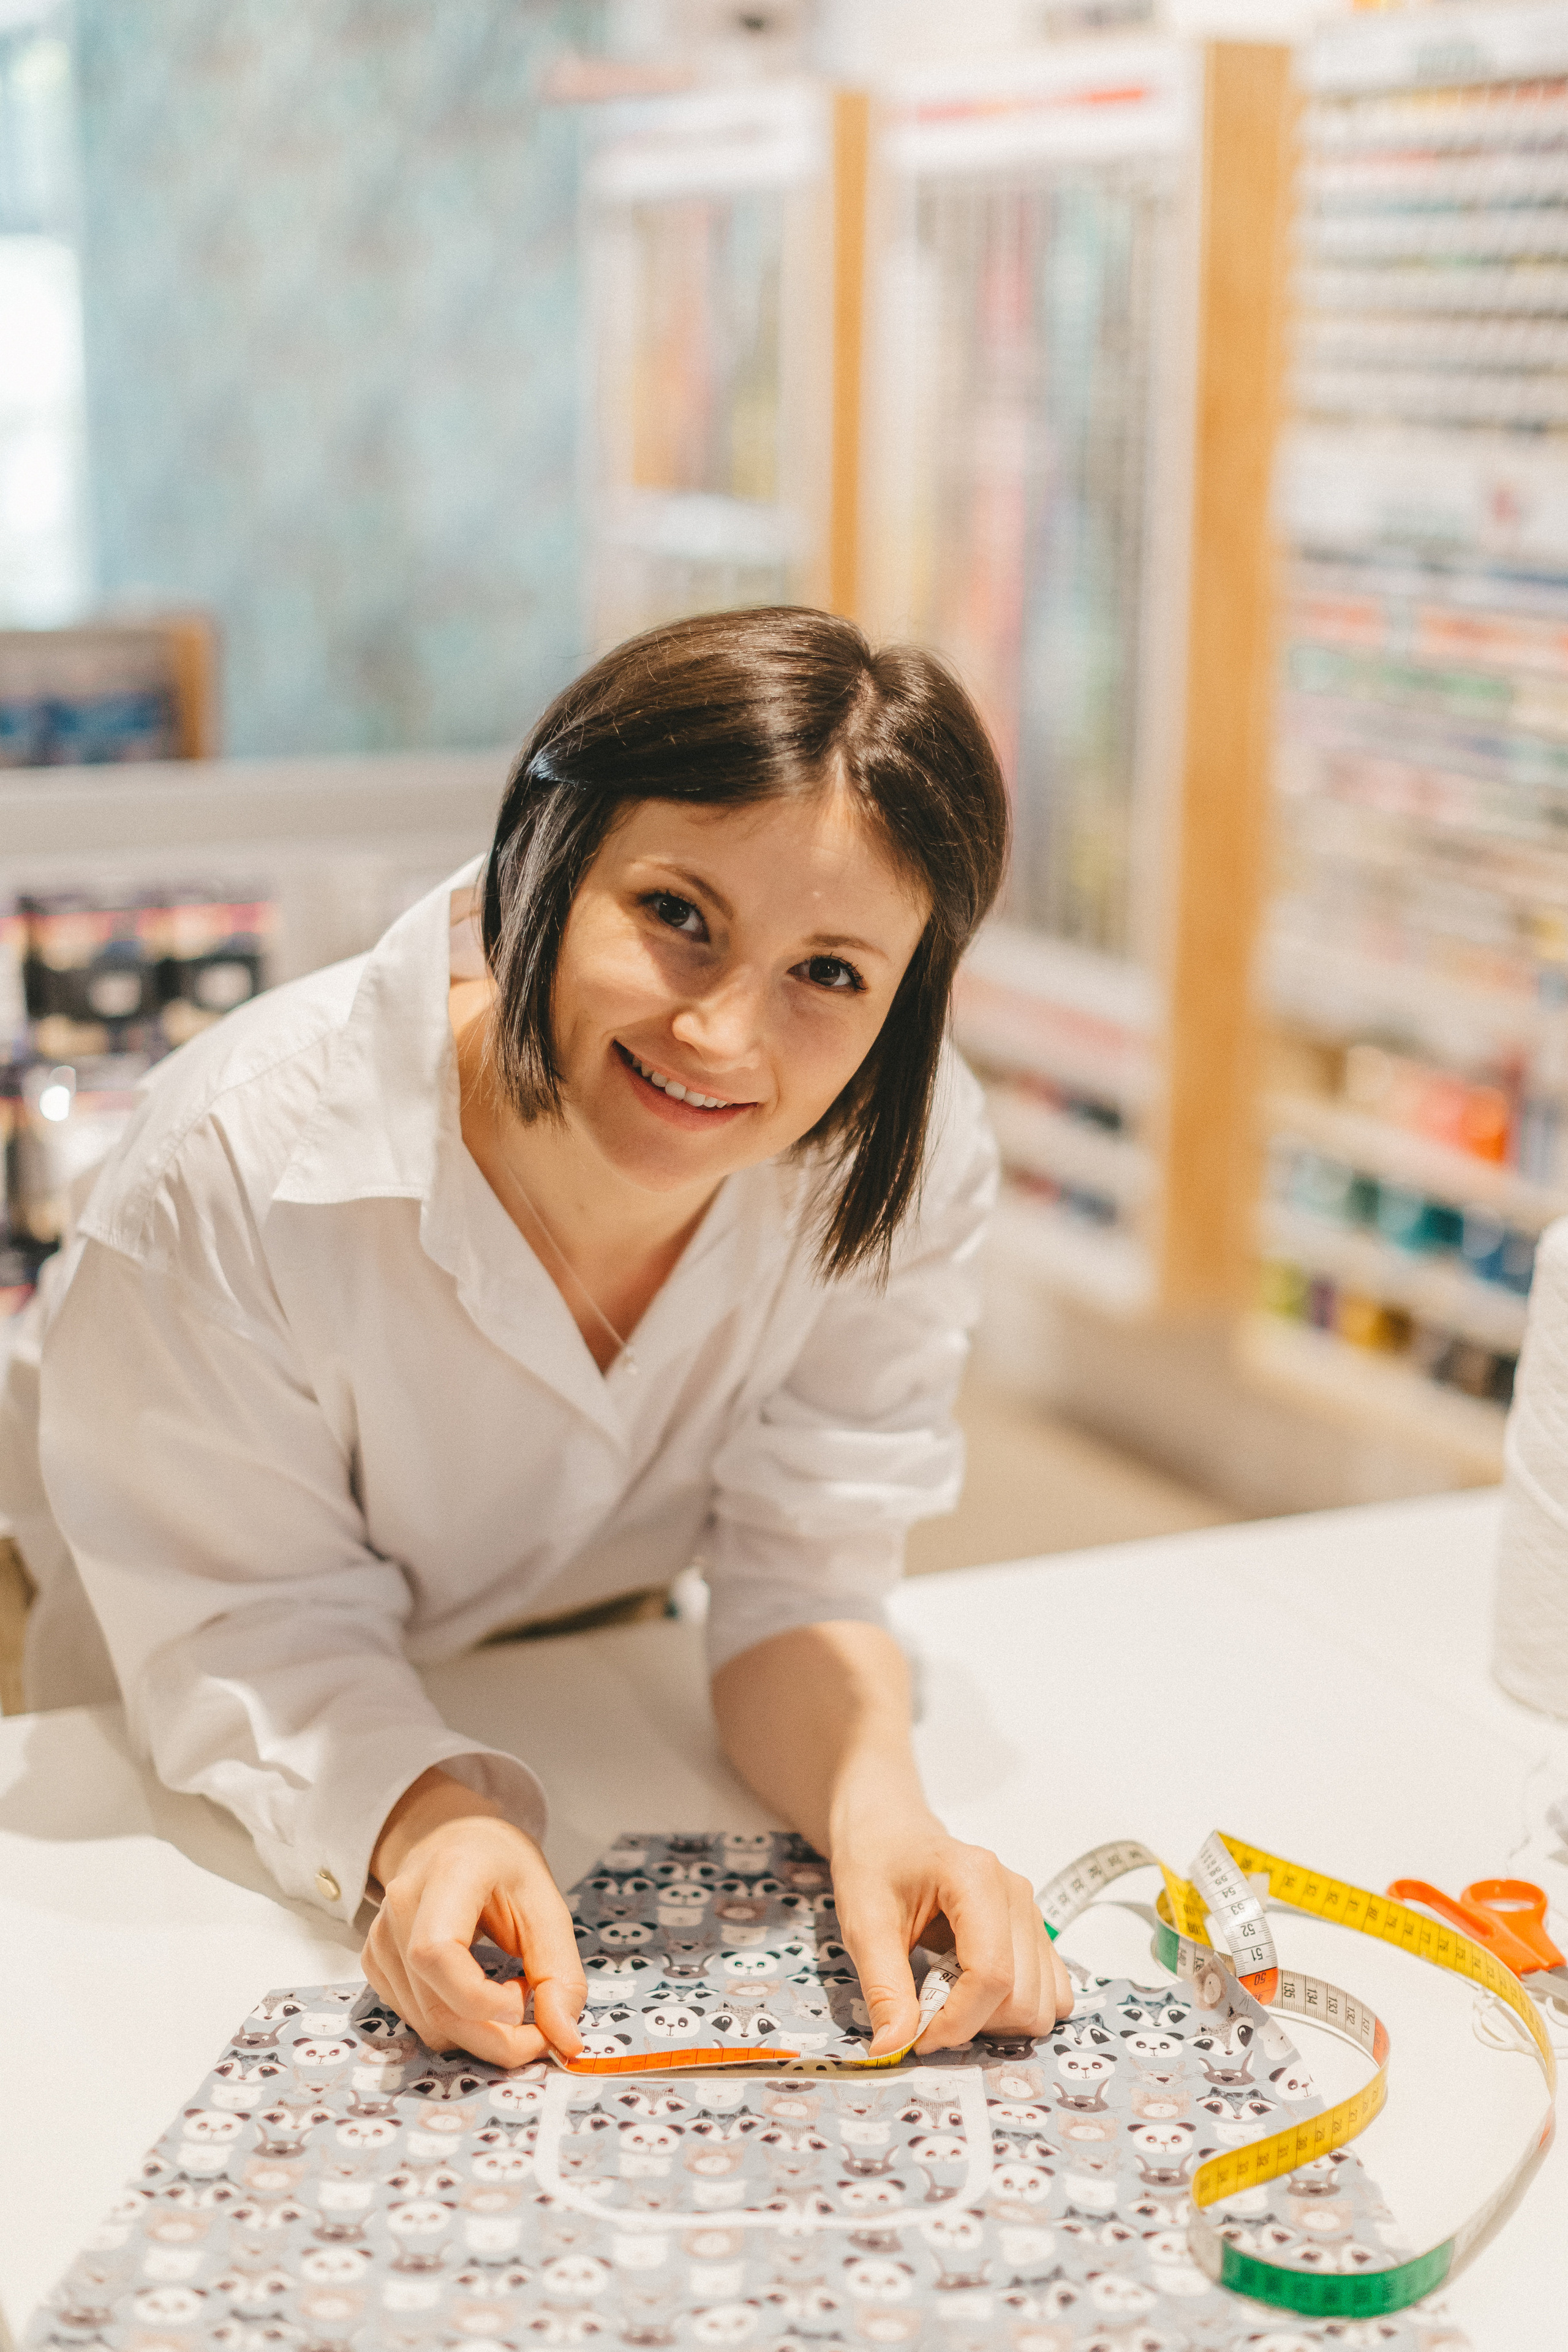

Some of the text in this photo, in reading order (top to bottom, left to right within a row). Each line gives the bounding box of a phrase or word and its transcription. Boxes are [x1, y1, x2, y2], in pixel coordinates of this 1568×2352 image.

[1215, 1875, 1228, 1886] 55
[1222, 1887, 1237, 1898] 54
[1231, 1902, 1245, 1915] 53
[1241, 1923, 1256, 1937] 52
[1251, 1947, 1264, 1961] 51
[939, 1972, 954, 1983] 18
[1254, 1972, 1266, 1986] 50
[1284, 1982, 1295, 1999] 135
[1307, 1988, 1317, 2005] 134
[1329, 1996, 1338, 2015] 133
[1347, 2006, 1355, 2025] 132
